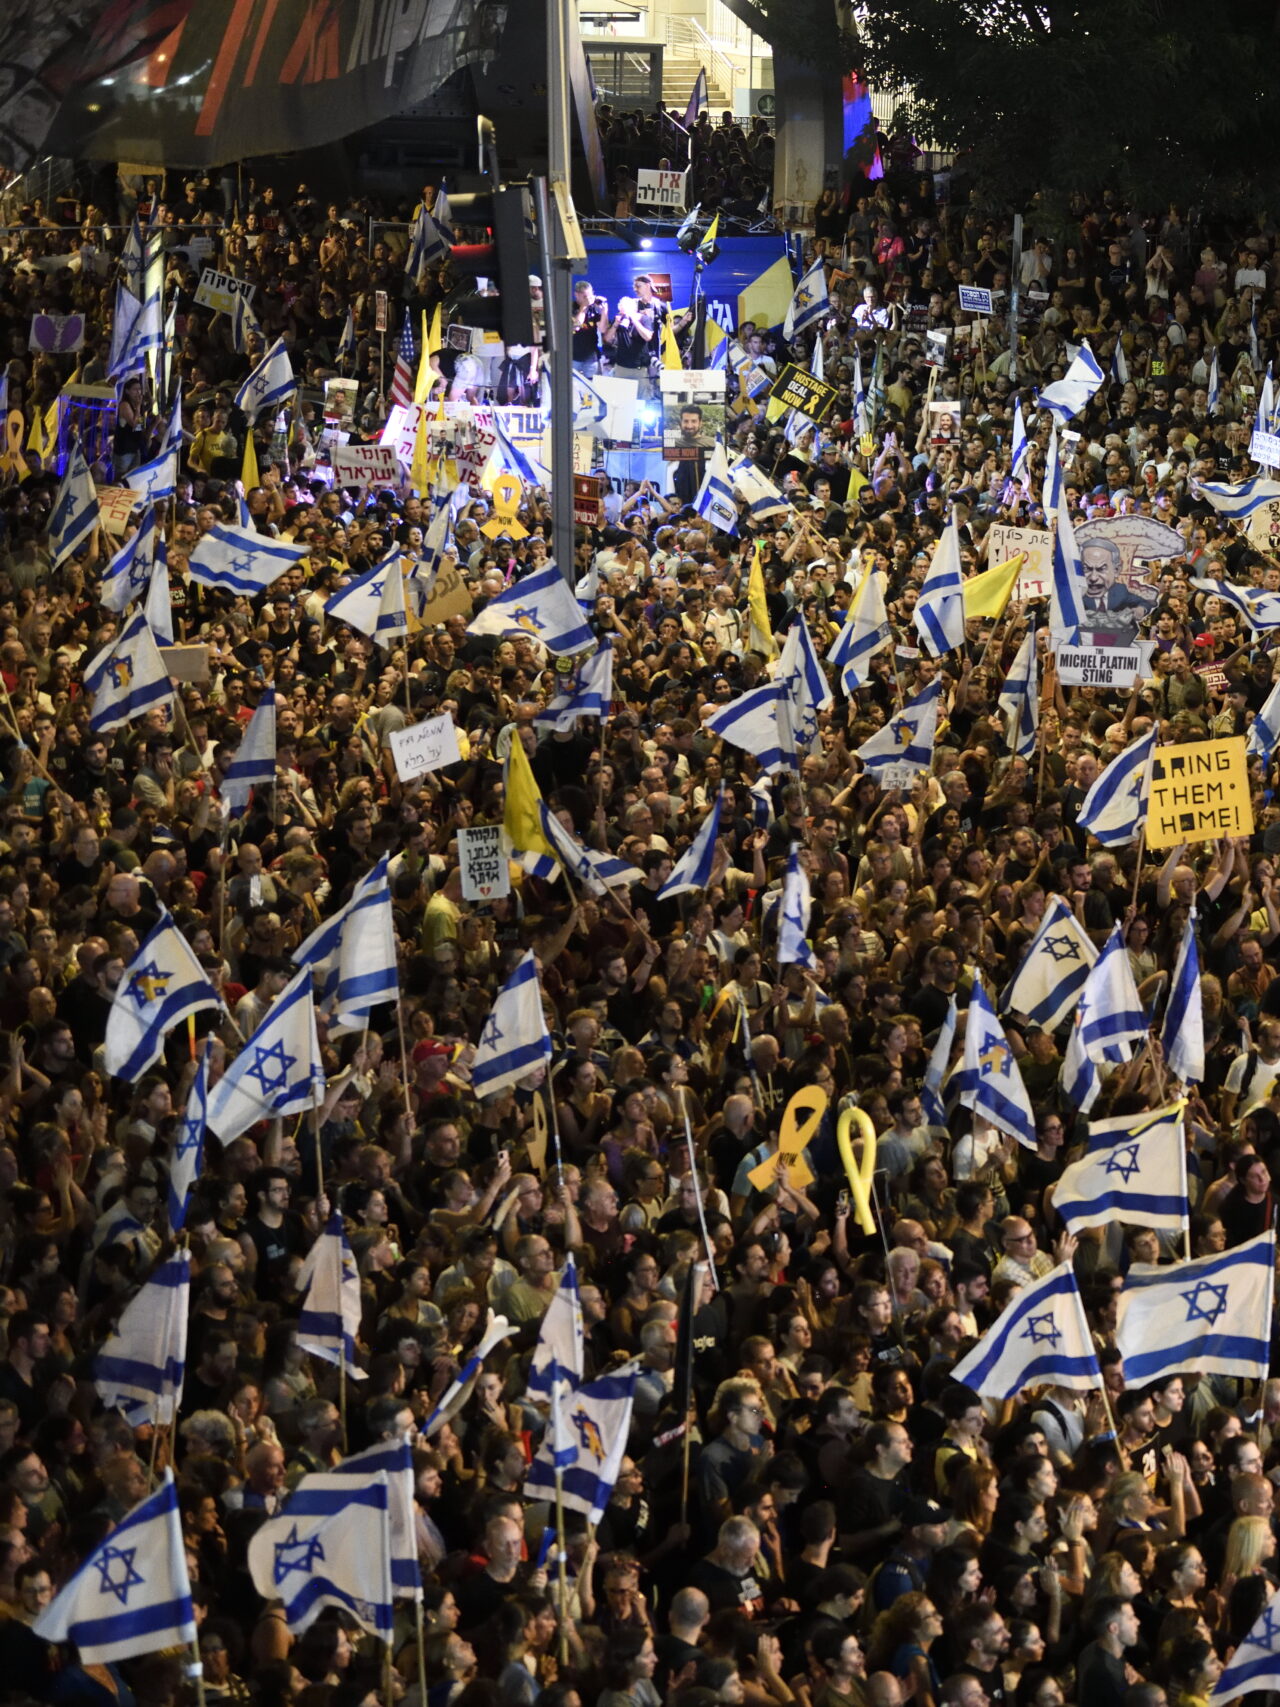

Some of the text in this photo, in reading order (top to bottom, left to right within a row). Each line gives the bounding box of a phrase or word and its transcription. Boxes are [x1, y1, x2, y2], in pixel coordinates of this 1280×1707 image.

[788, 381, 807, 398] DEAL
[793, 372, 828, 398] HOSTAGE
[781, 391, 804, 408] NOW
[1060, 654, 1138, 670] MICHEL PLATINI
[1082, 669, 1113, 683] STING
[1154, 782, 1223, 807] THEM
